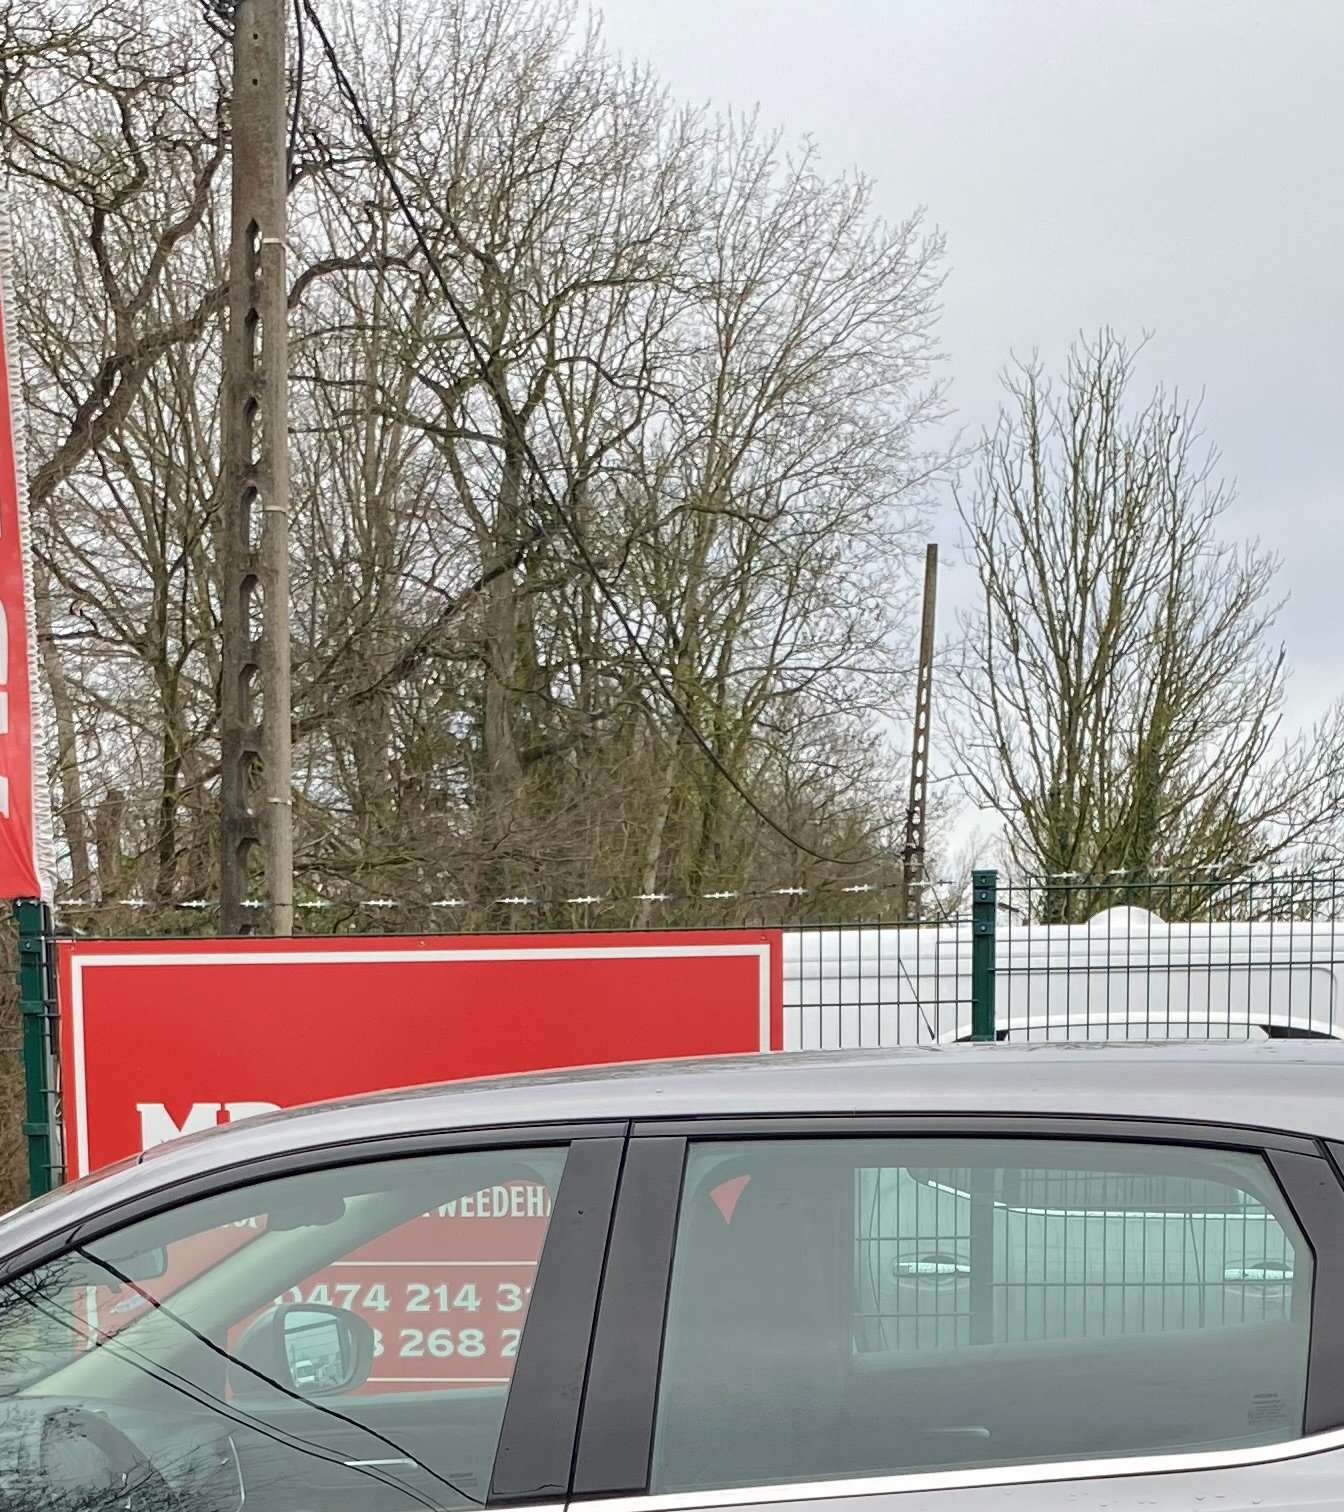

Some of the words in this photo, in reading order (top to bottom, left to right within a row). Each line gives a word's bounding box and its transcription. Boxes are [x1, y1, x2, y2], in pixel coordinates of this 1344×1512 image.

[422, 1185, 552, 1218] EEDEH
[405, 1283, 481, 1313] 214
[496, 1283, 532, 1313] 3
[399, 1328, 486, 1358] 268
